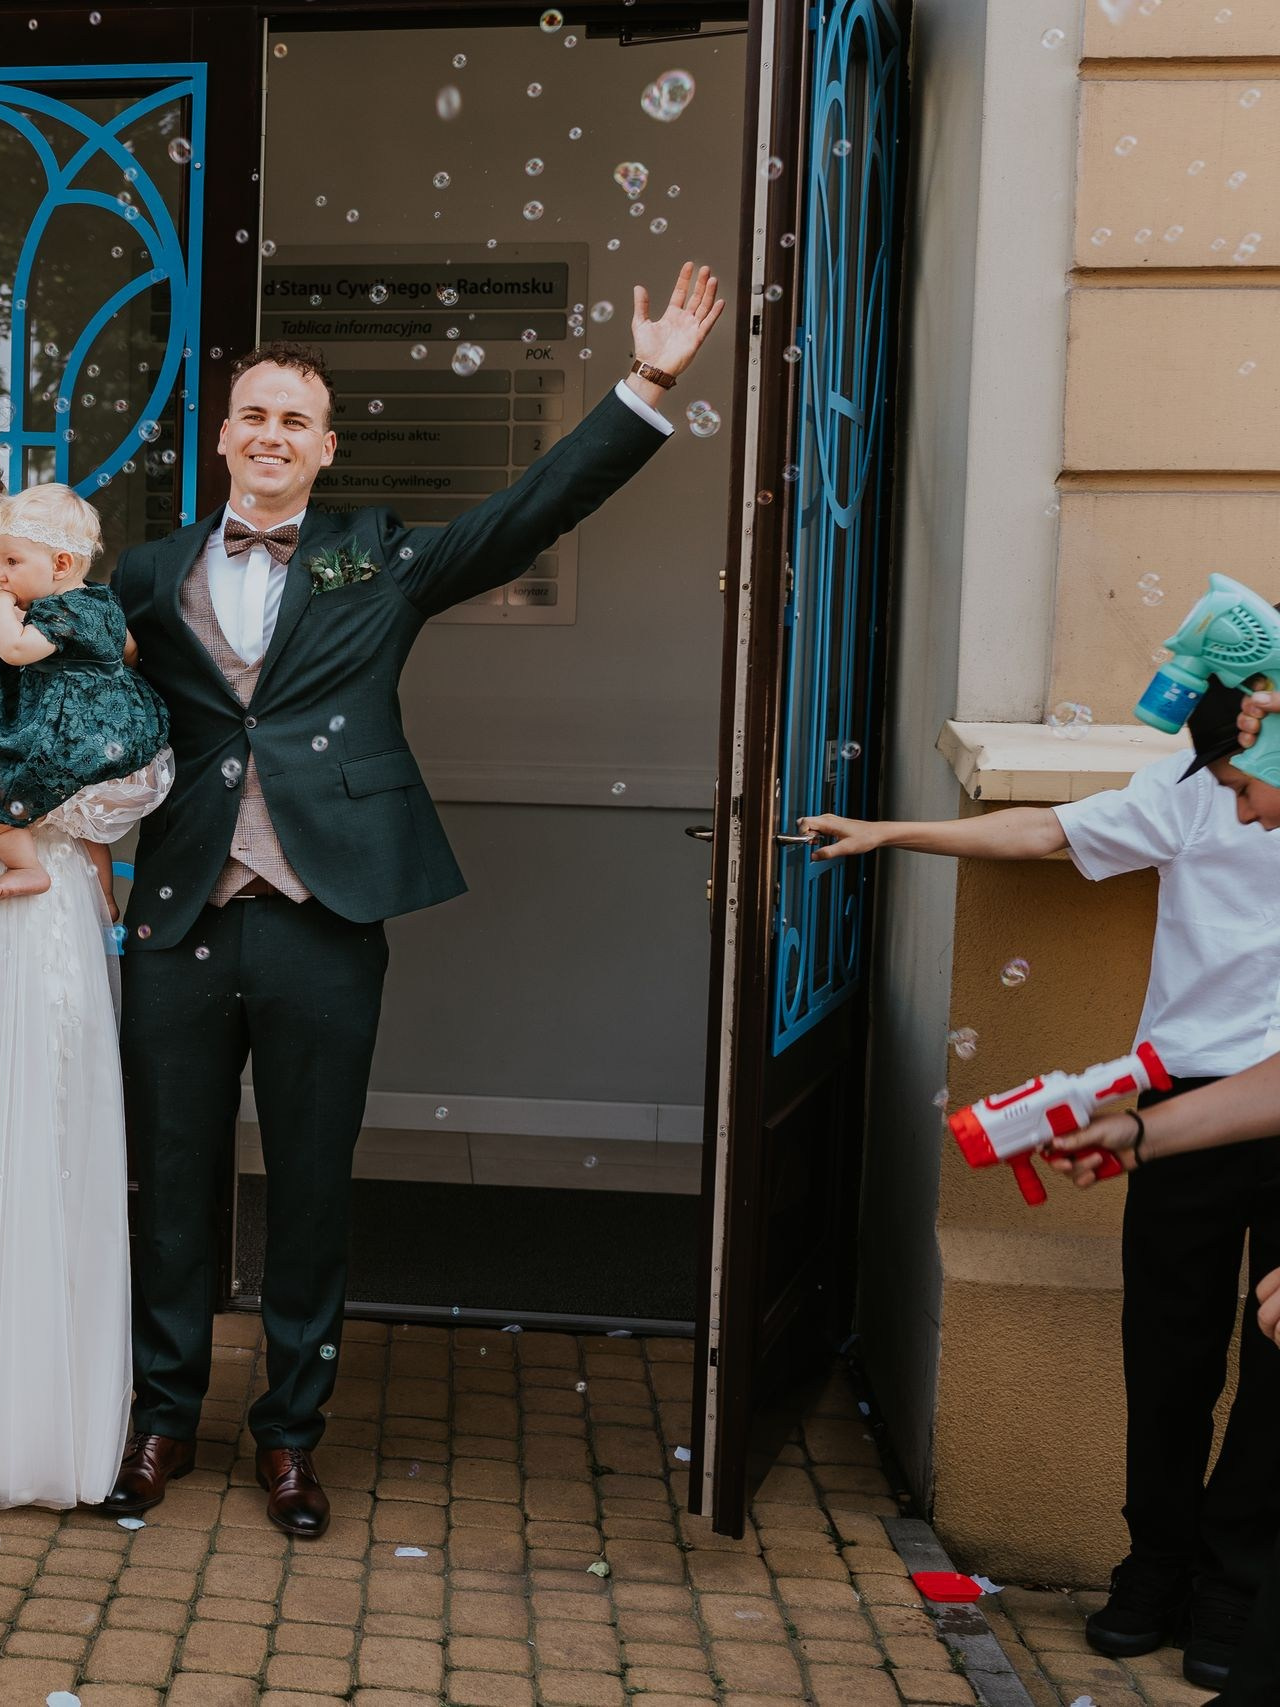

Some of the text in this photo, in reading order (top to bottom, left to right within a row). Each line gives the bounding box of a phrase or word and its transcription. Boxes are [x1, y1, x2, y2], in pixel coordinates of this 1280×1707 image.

[279, 280, 332, 296] Stanu
[457, 277, 553, 295] Radomsku
[282, 320, 433, 340] Tablica informacyjna
[360, 428, 407, 445] odpisu
[408, 429, 441, 442] aktu:
[533, 439, 542, 451] 2
[342, 475, 380, 487] Stanu
[382, 473, 452, 491] Cywilnego
